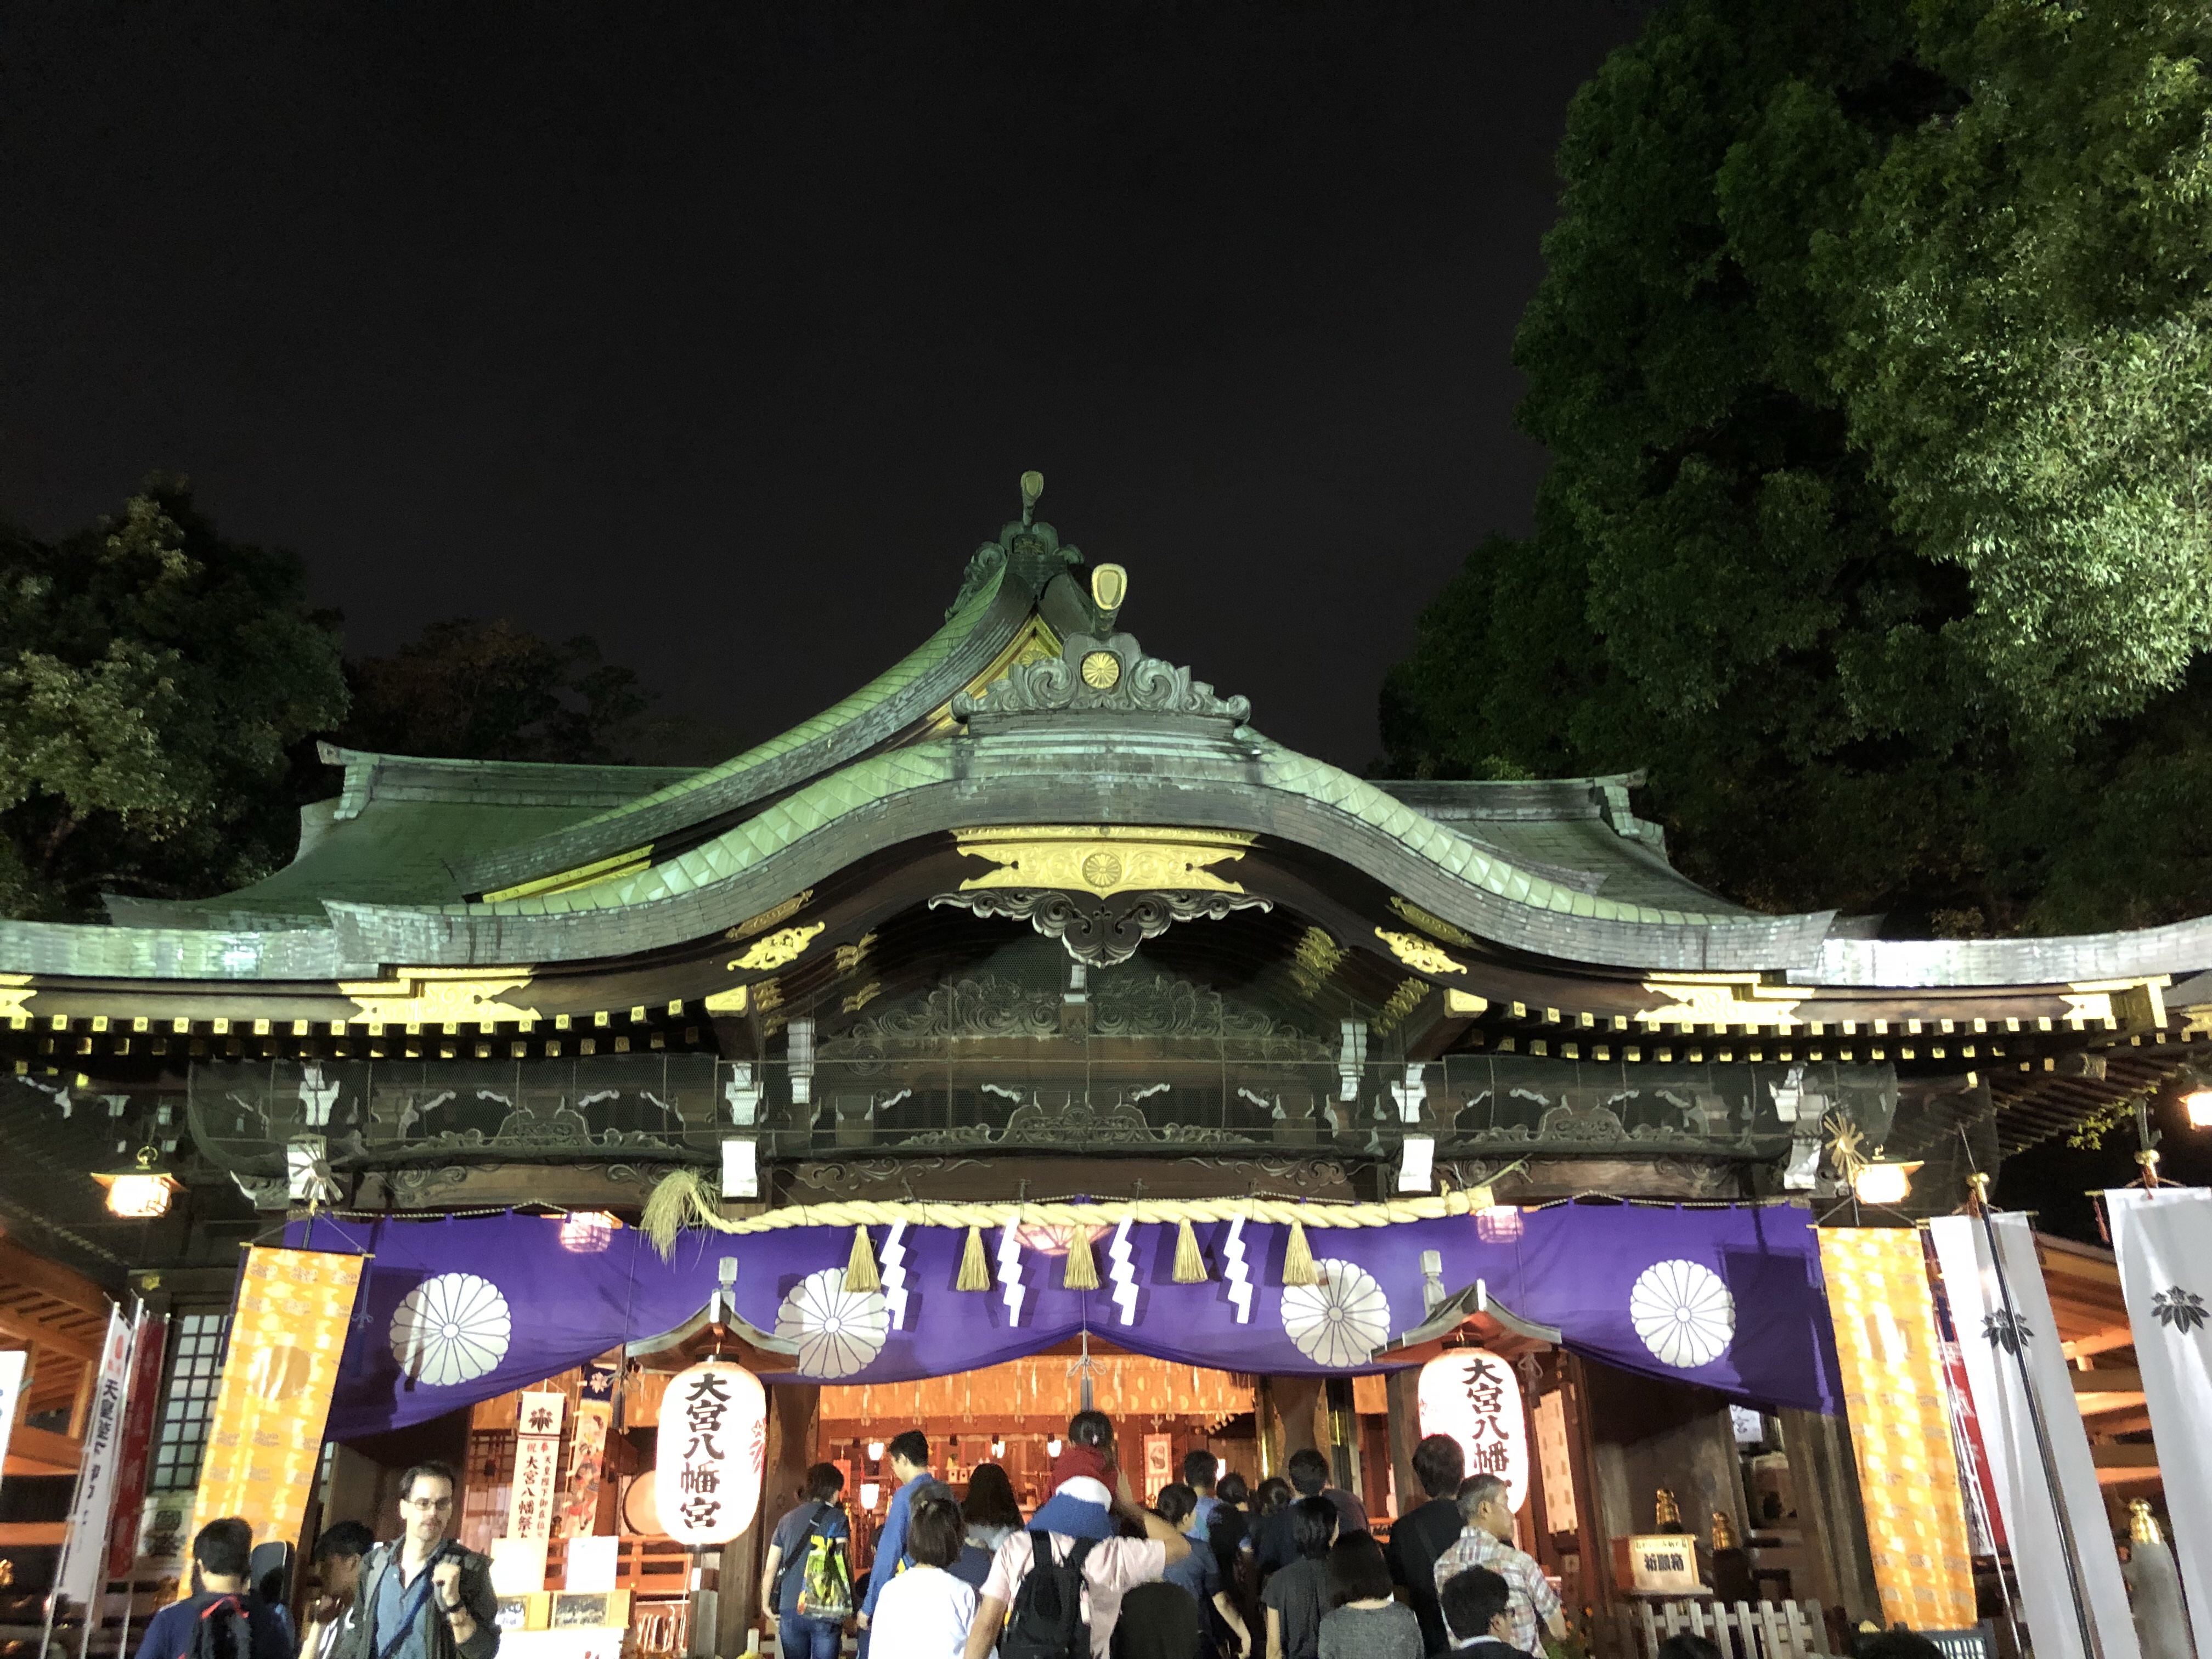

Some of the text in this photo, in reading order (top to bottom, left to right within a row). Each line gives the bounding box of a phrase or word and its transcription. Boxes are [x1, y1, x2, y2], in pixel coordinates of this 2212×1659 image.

[680, 1373, 732, 1529] 大宮八幡宮
[1462, 1358, 1513, 1488] 大宮八幡
